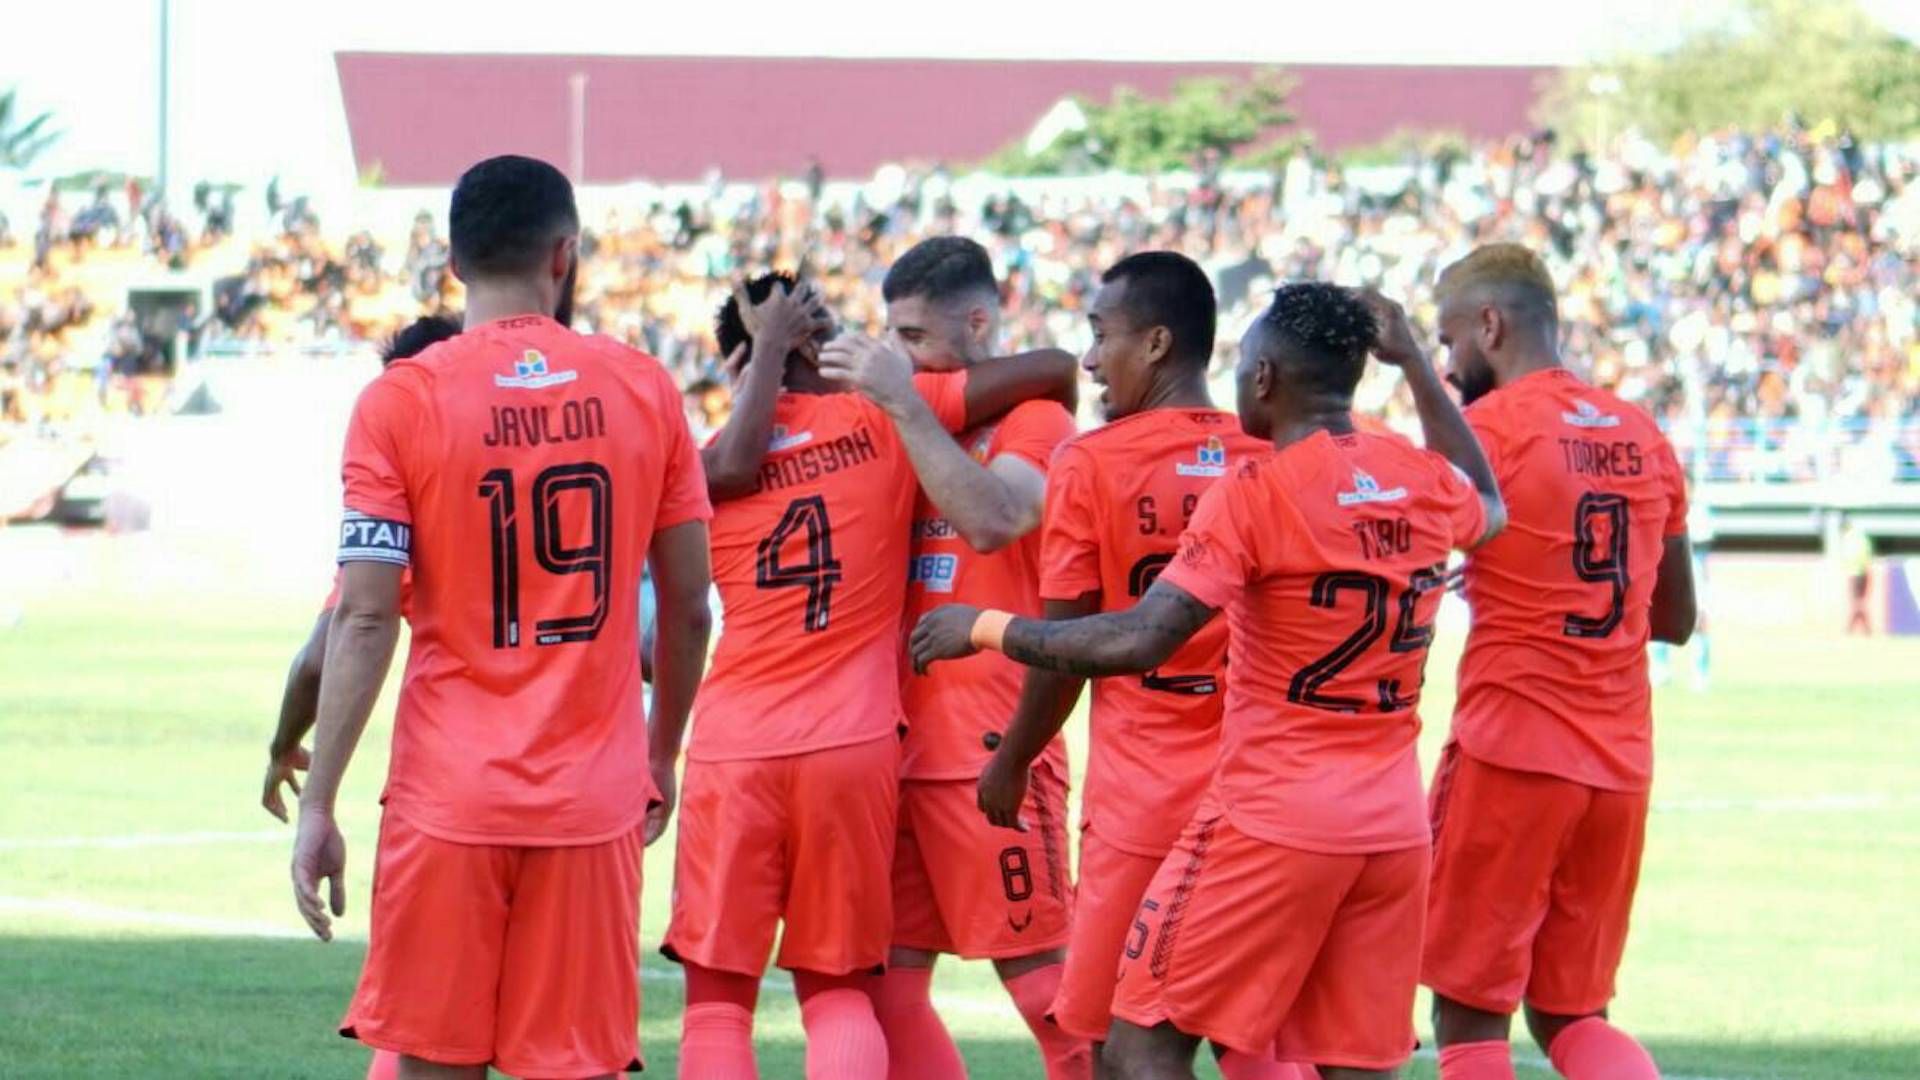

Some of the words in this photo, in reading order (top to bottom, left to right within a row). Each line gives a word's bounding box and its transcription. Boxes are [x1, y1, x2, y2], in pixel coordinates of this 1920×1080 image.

[484, 397, 606, 447] JAVLON
[1558, 438, 1643, 477] TORRES
[478, 461, 612, 649] 19
[757, 495, 842, 631] 4
[1562, 491, 1630, 638] 9
[1000, 847, 1032, 901] 8
